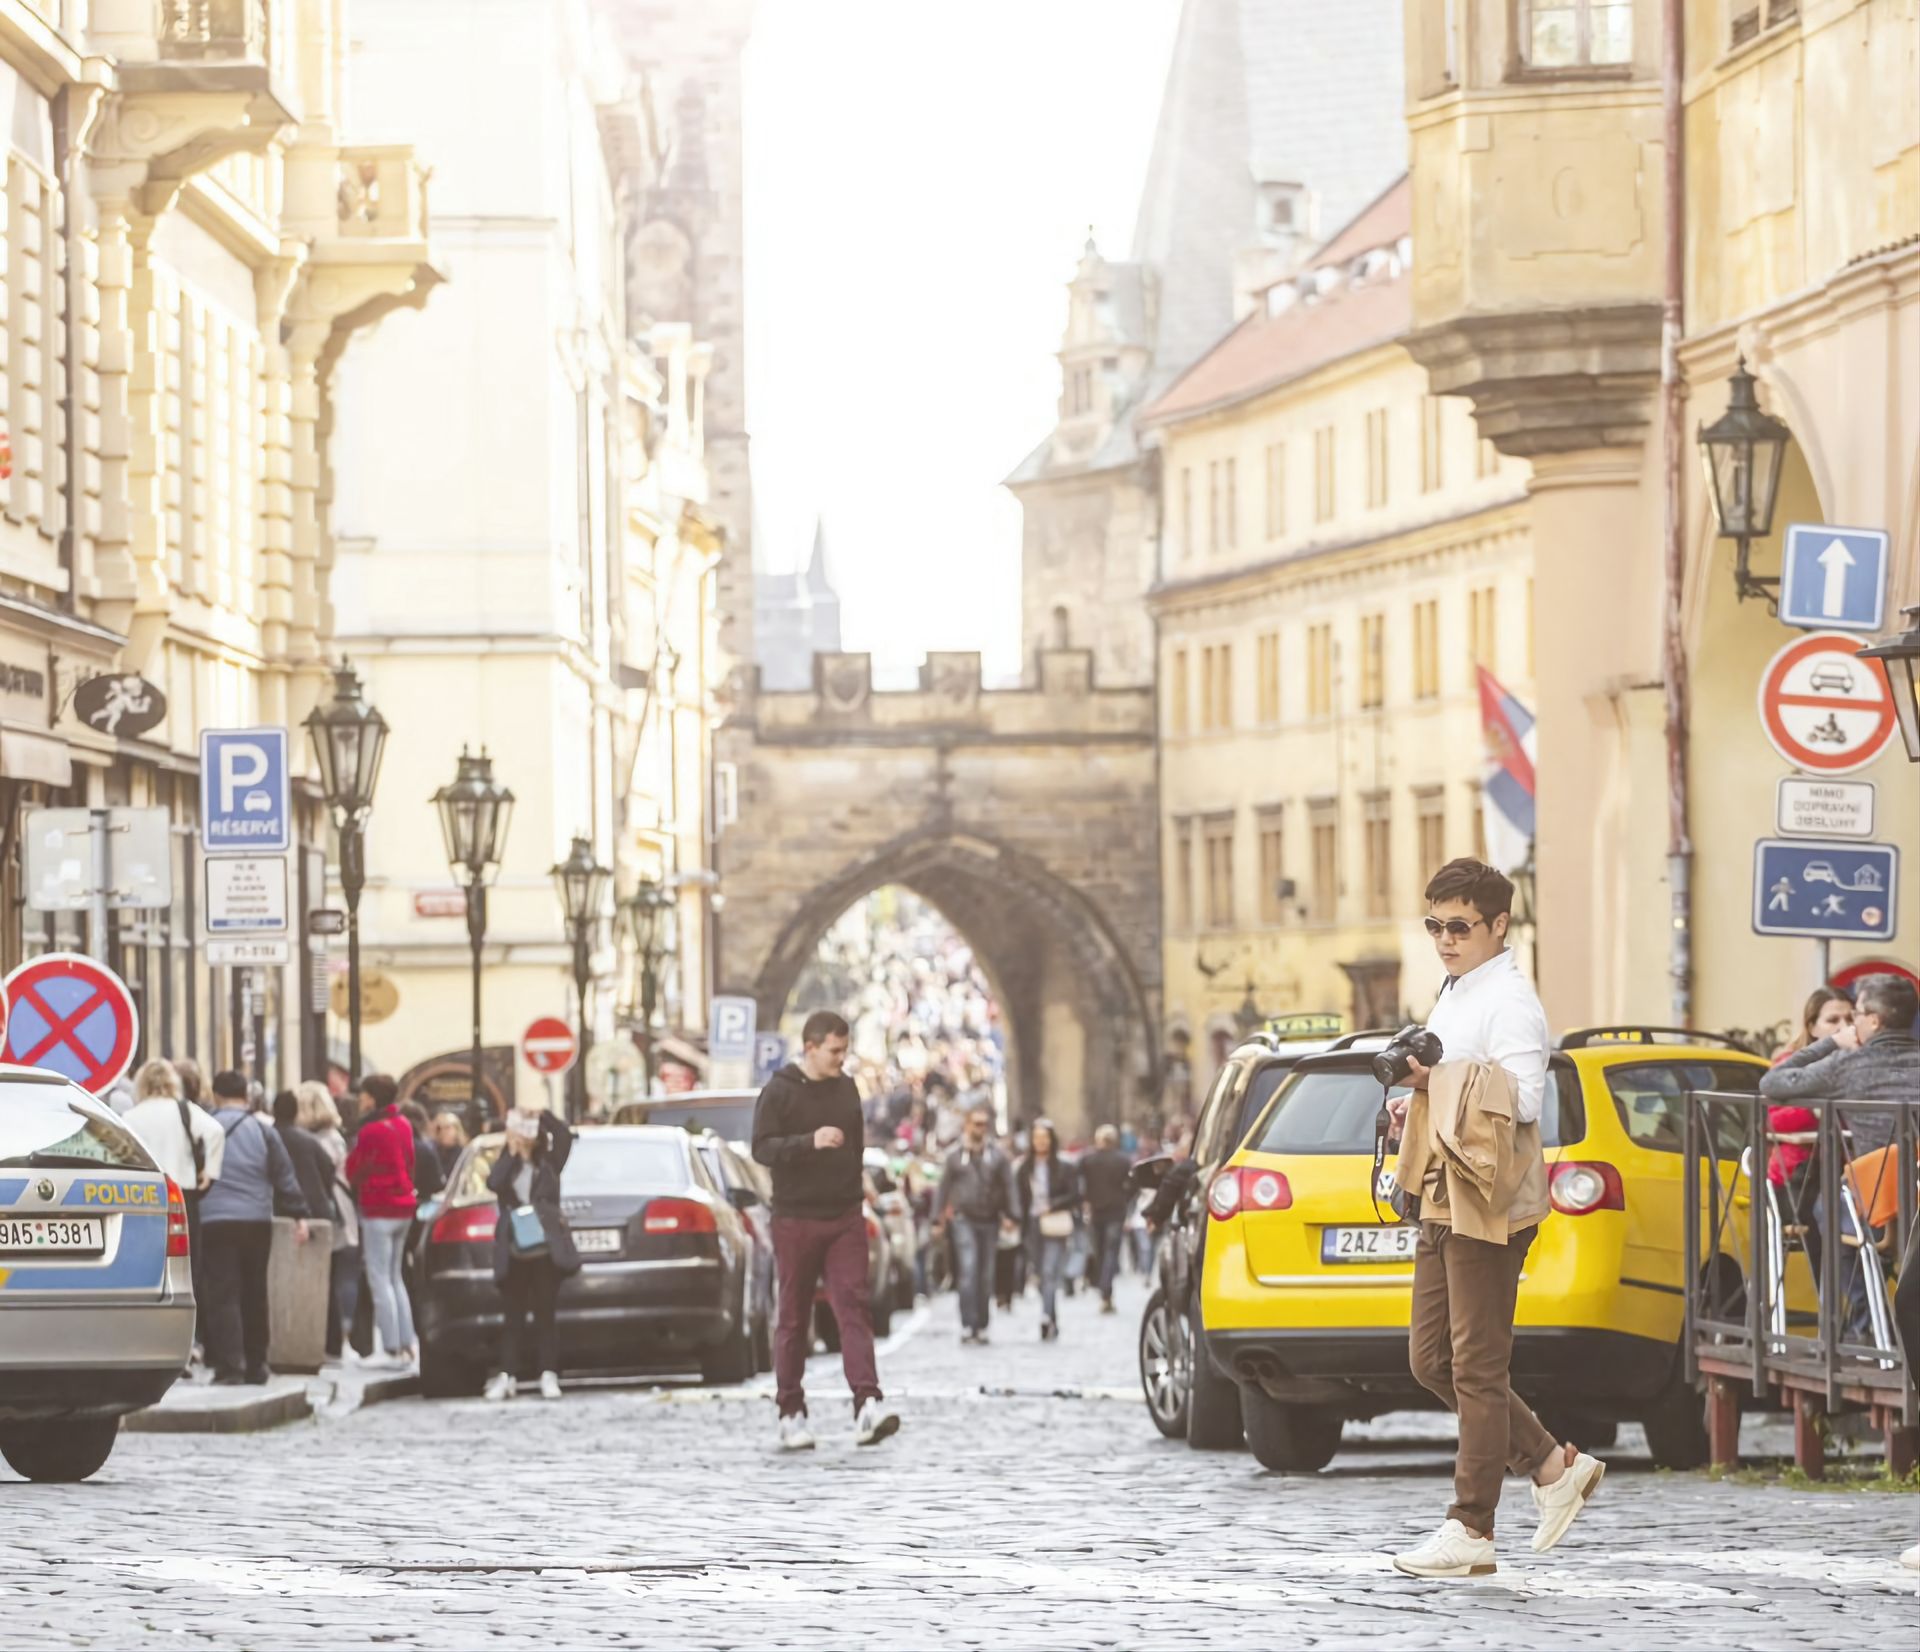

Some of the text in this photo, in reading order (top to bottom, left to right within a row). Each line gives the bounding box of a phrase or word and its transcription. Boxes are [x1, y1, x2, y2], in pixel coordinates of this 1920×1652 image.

[220, 743, 269, 813] P
[210, 817, 280, 836] RÉSERVÉ
[84, 1183, 160, 1205] POLICIE
[48, 1222, 92, 1245] 5381
[1340, 1231, 1379, 1253] 2AZ
